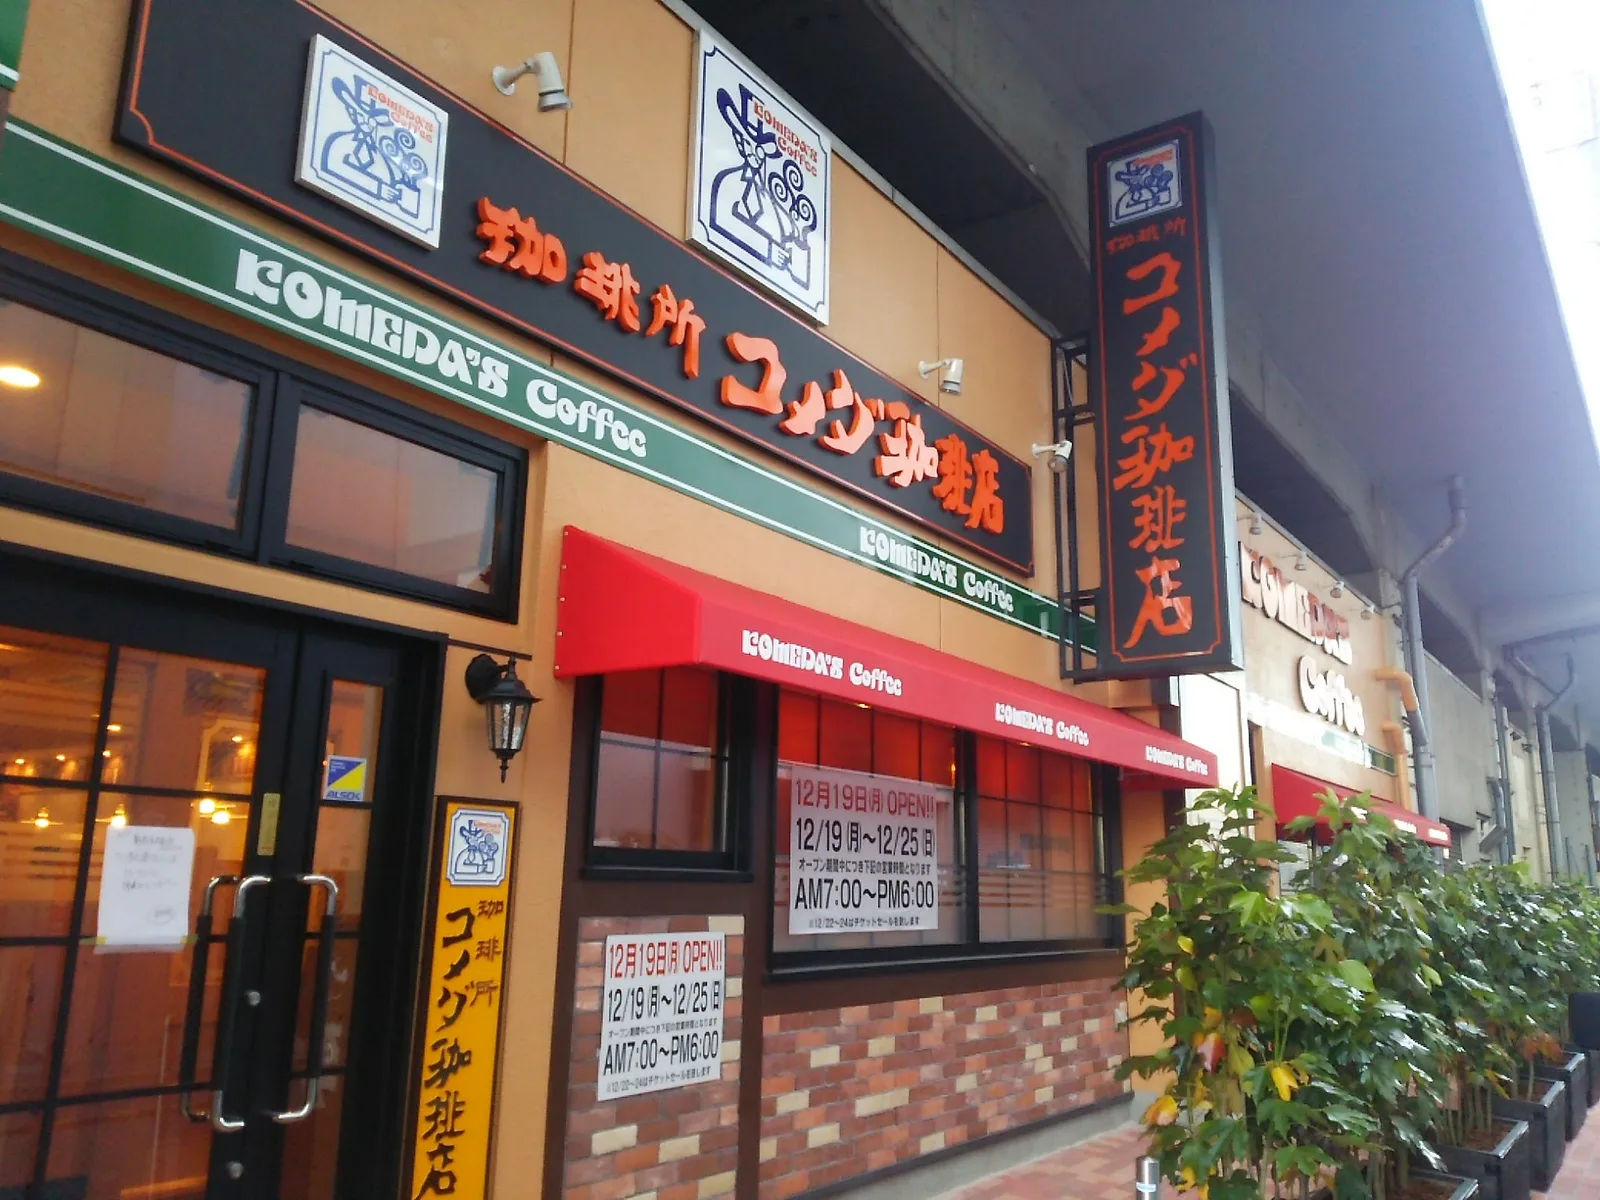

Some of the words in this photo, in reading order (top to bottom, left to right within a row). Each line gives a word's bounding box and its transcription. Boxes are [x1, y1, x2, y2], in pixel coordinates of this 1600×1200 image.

[235, 249, 509, 398] KOMEDA'S
[526, 377, 648, 458] Coffee
[860, 526, 957, 588] KOMEDA'S
[964, 571, 1014, 613] Coffee
[742, 629, 843, 679] KOMEDA'S
[849, 662, 902, 696] Coffee
[995, 702, 1053, 736] KOMEDA'S
[1056, 720, 1089, 747] Coffee
